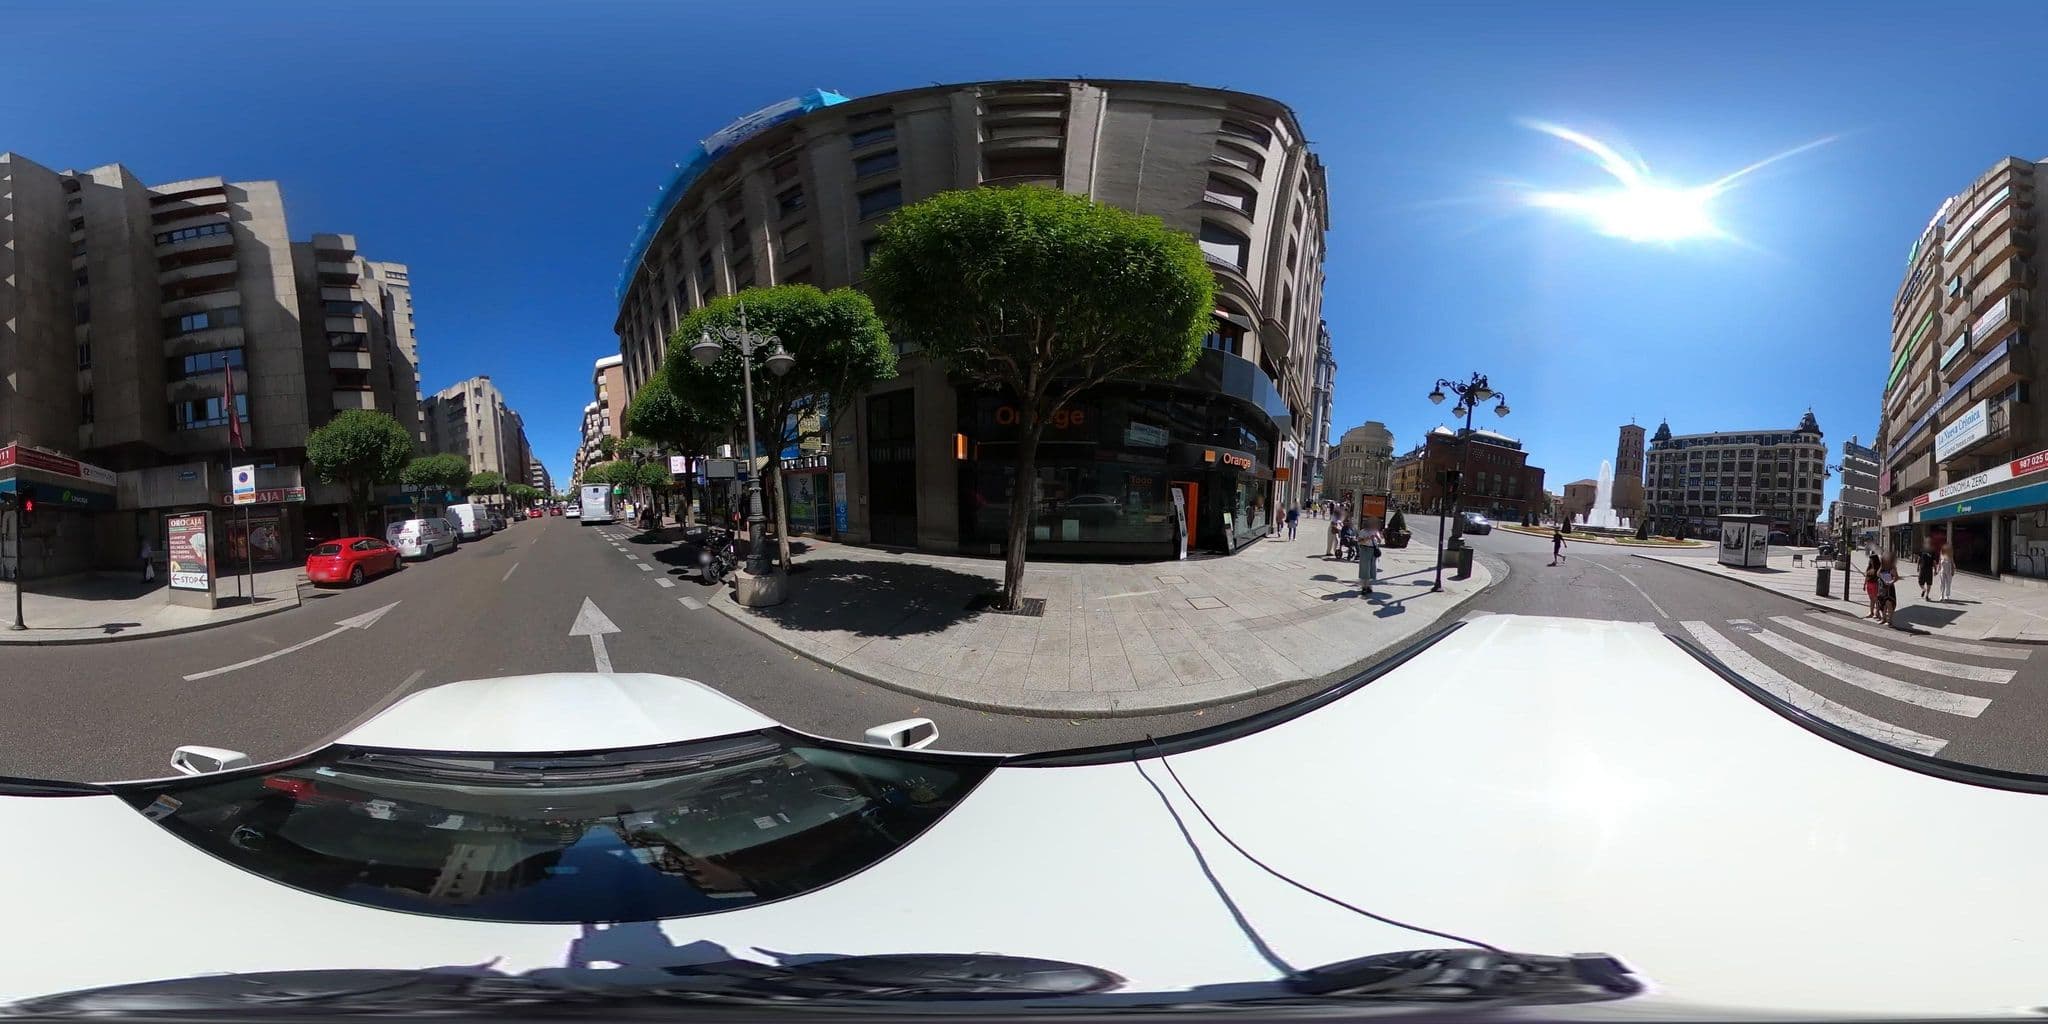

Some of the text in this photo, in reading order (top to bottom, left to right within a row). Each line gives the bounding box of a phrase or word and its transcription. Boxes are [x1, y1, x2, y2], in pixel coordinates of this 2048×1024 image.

[1223, 452, 1251, 470] Orange
[2031, 454, 2044, 465] 025
[1971, 474, 1988, 488] ZERO
[181, 576, 199, 584] STOP
